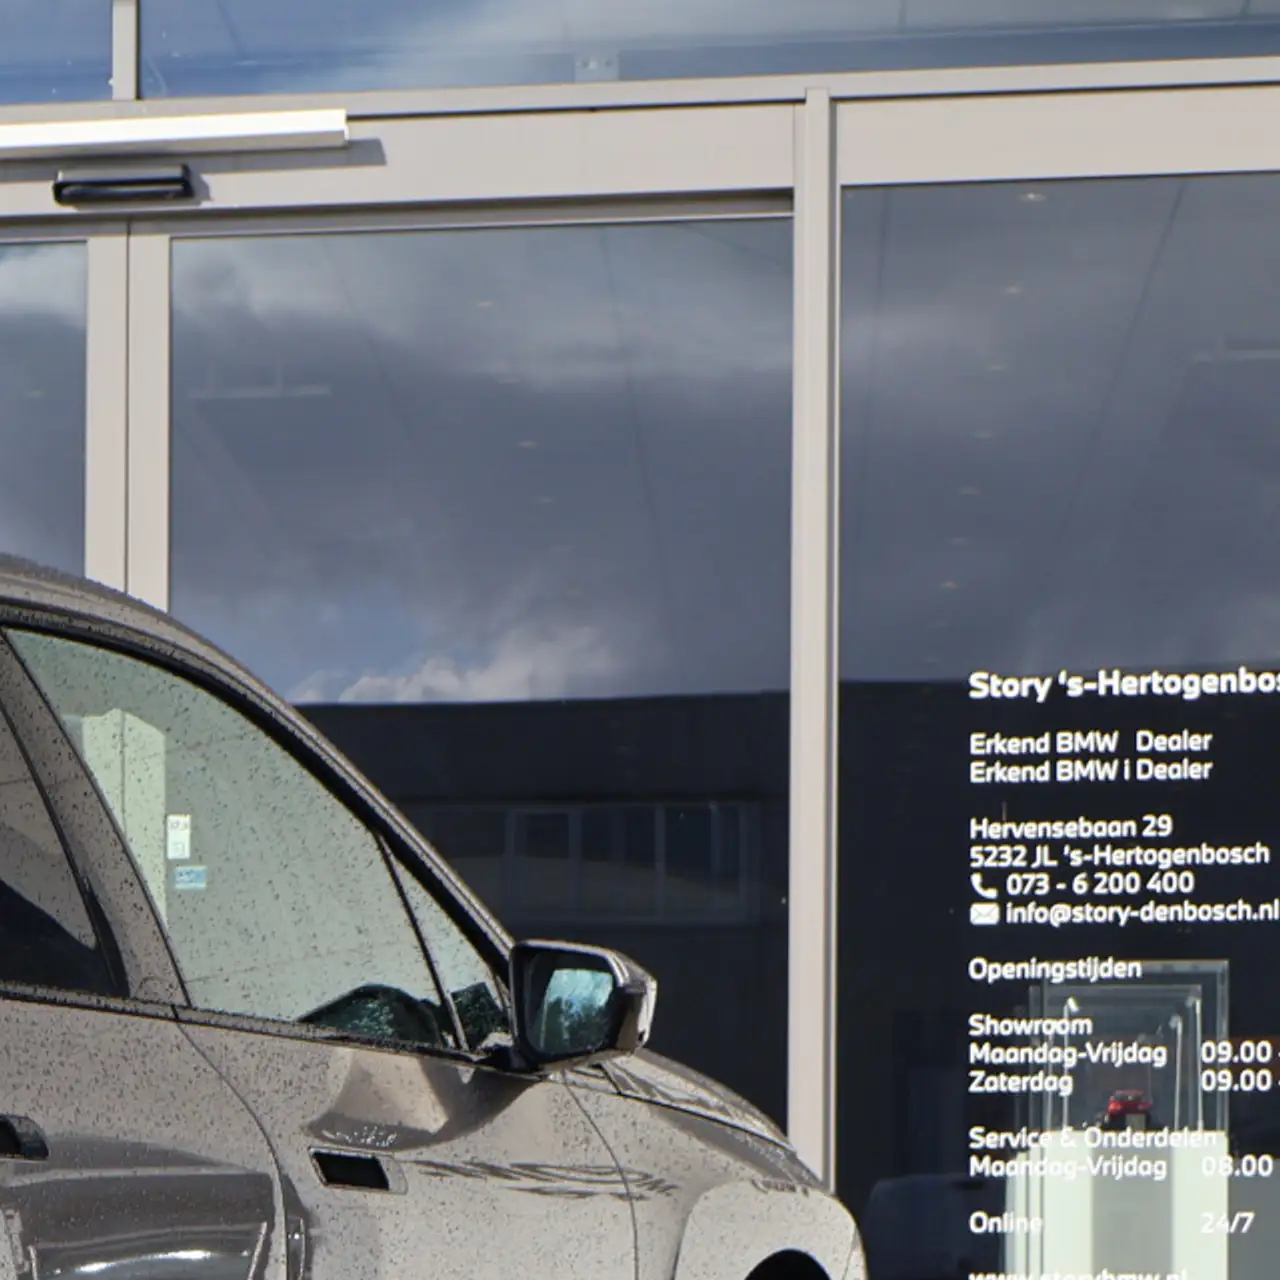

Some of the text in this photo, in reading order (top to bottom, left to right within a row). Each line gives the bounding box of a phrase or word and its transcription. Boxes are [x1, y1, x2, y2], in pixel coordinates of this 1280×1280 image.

[968, 670, 1053, 703] Story
[970, 728, 1213, 755] Erkend BMW Dealer
[970, 757, 1213, 783] Erkend BMW i Dealer
[969, 813, 1174, 840] Hervensebaan 29
[969, 843, 1028, 868] 5232
[1030, 844, 1059, 869] JL
[1006, 872, 1050, 896] 073
[1072, 872, 1089, 895] 6
[1093, 872, 1141, 894] 200
[1146, 870, 1195, 893] 400
[1005, 898, 1280, 928] info@story-denbosch.nl
[968, 956, 1142, 985] Openingstijden
[968, 1013, 1093, 1037] Showroom
[969, 1040, 1273, 1069] Maandag-Vrijdag 09.00
[968, 1068, 1273, 1096] Zaterdag 09.00
[968, 1125, 1218, 1150] Service & Onderdelen
[969, 1154, 1274, 1181] Maandag-Vrijdag 08.00
[968, 1210, 1256, 1234] Online 24/7
